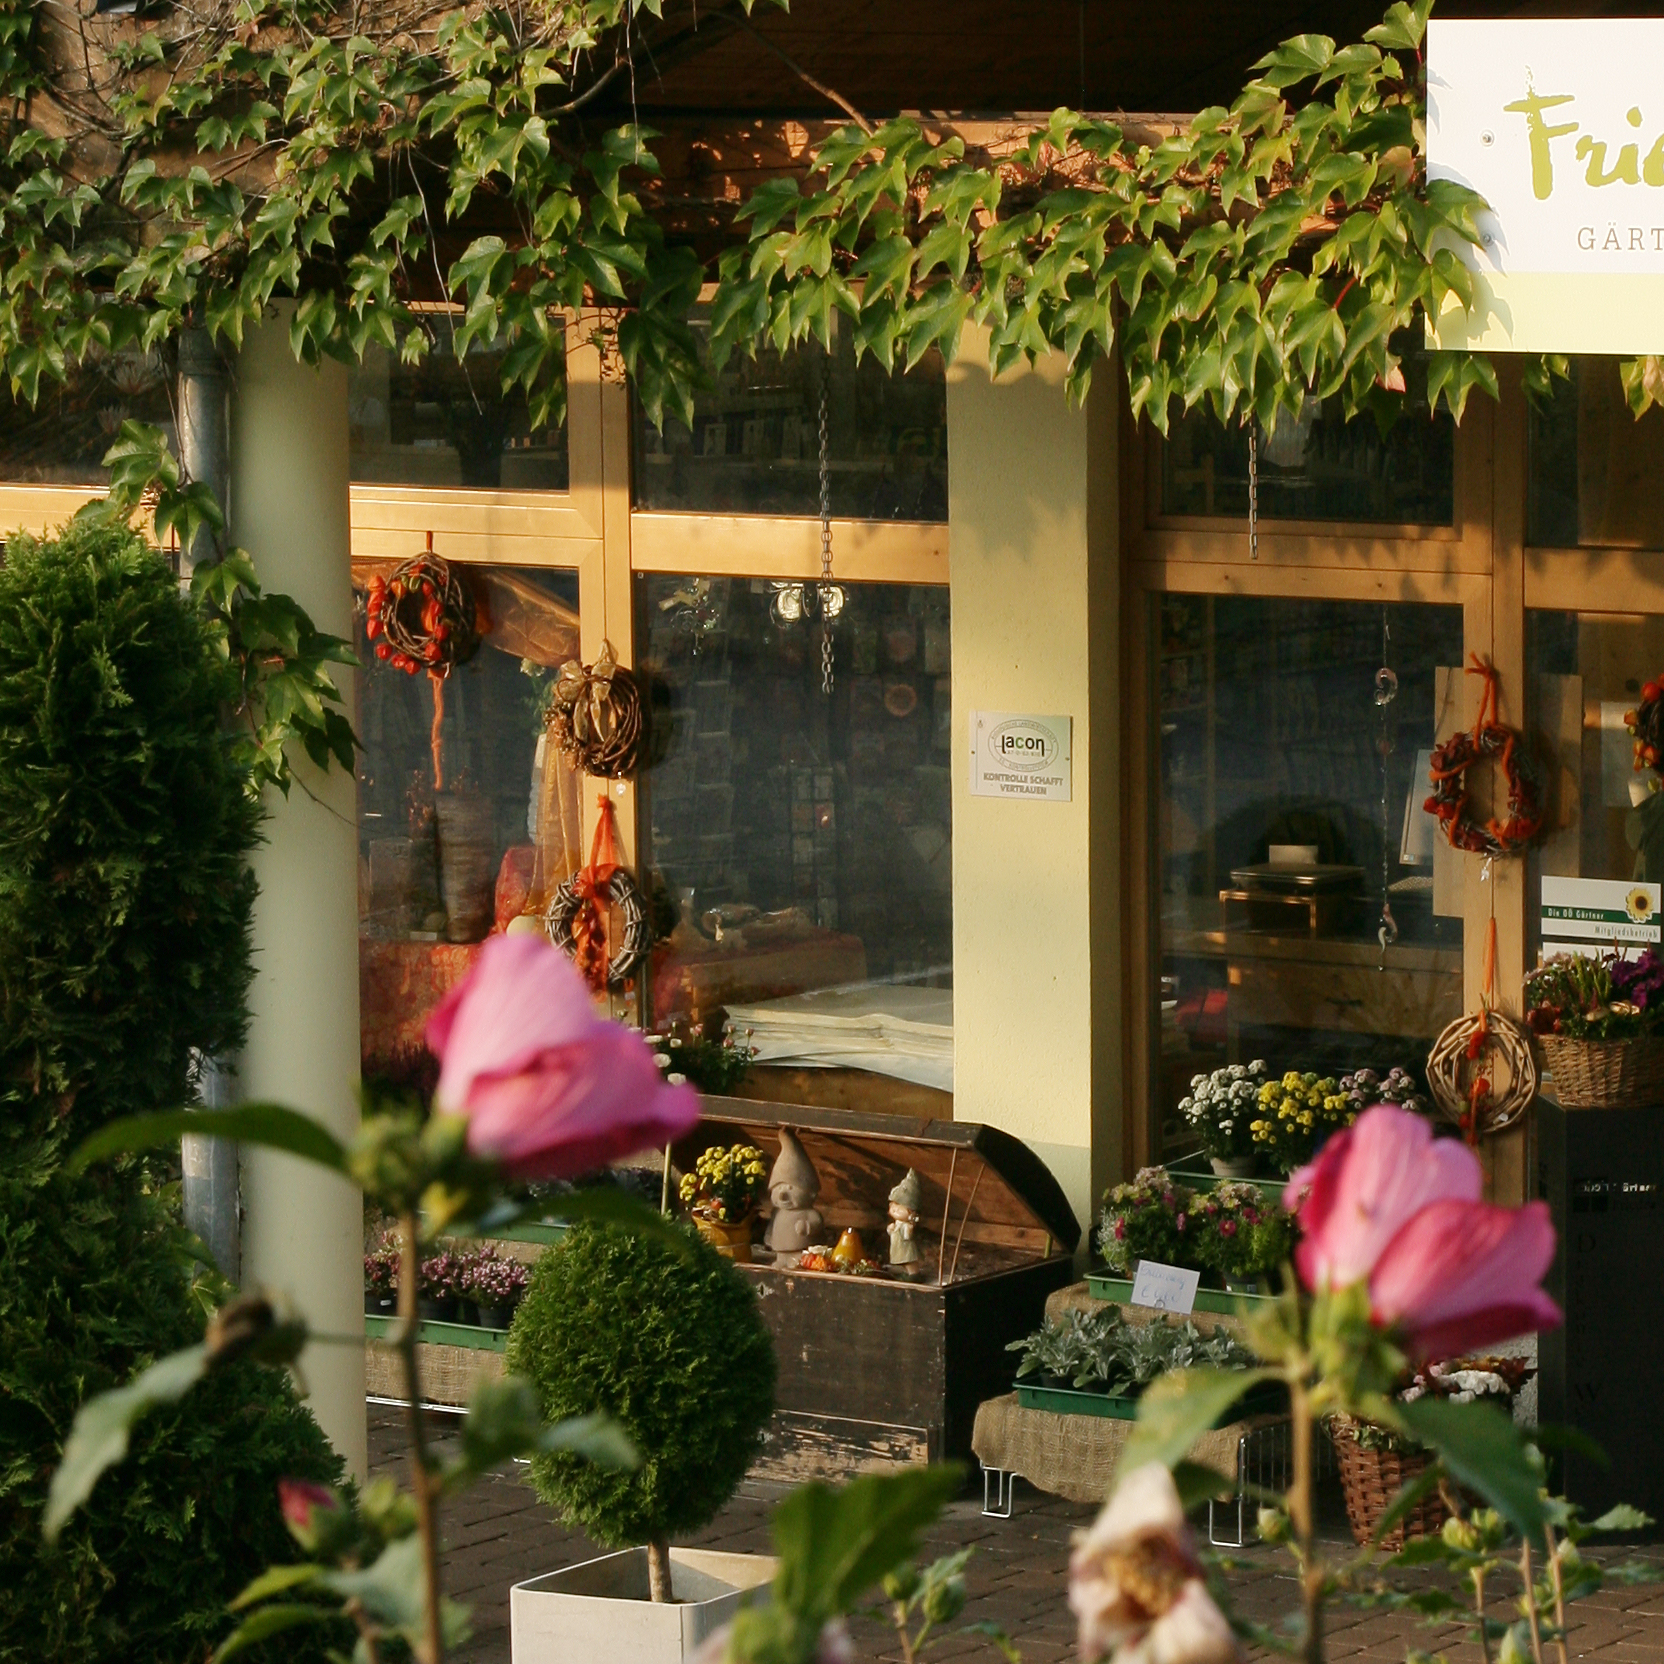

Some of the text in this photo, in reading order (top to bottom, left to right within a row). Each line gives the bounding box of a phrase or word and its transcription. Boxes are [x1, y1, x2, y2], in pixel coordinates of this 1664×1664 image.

[983, 773, 1063, 786] KONTROLLE SCHAFFT
[1000, 784, 1047, 795] VERTRAUEN
